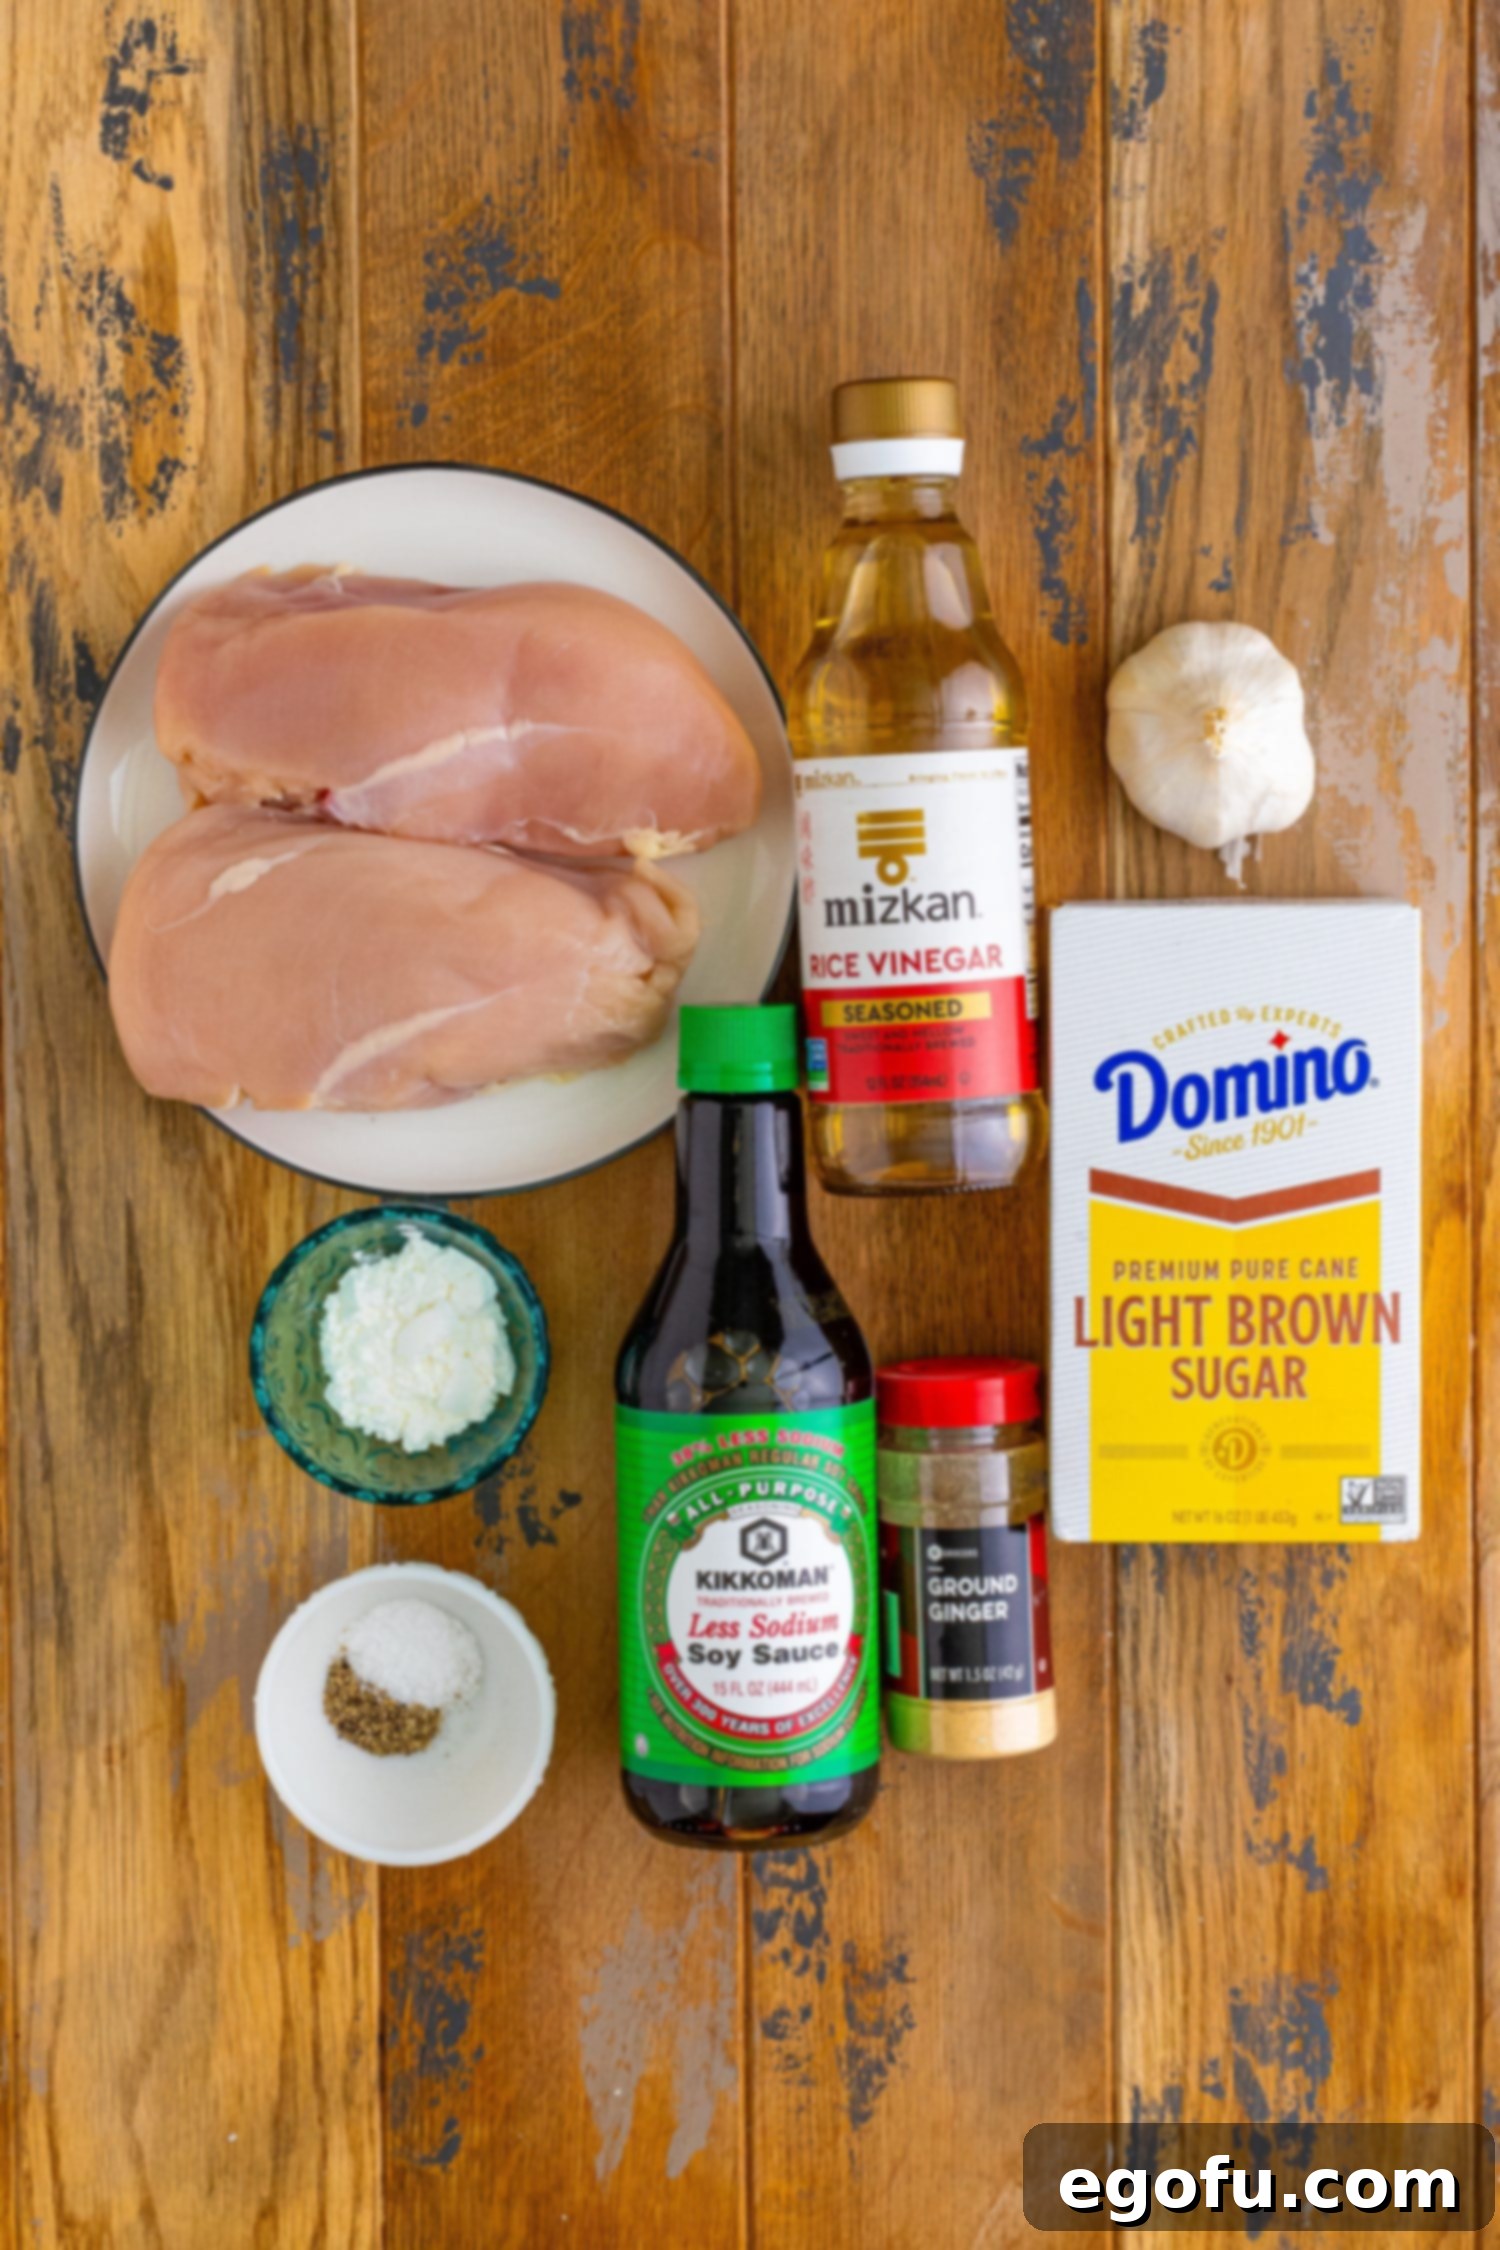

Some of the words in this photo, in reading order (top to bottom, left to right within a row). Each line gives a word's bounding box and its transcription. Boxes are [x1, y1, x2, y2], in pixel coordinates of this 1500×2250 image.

[824, 884, 977, 928] mizkan
[810, 952, 860, 979] RICE
[866, 944, 1003, 976] VINEGAR
[843, 998, 963, 1024] SEASONED
[1152, 1008, 1231, 1050] CRAFTED
[1261, 1005, 1342, 1039] EXPERTS
[1094, 1038, 1371, 1143] Domino
[1113, 1260, 1220, 1281] PREMIUM
[1231, 1259, 1290, 1280] PURE
[1300, 1257, 1359, 1279] CANE
[1073, 1294, 1212, 1348] LIGHT
[1227, 1291, 1402, 1347] BROWN
[1170, 1355, 1308, 1400] SUGAR
[717, 1429, 769, 1449] LESS
[696, 1567, 829, 1590] KIKKOMAN
[928, 1575, 1018, 1596] GROUND
[688, 1613, 740, 1639] Less
[749, 1611, 839, 1638] Sodium
[928, 1602, 1009, 1622] GINGER
[688, 1643, 741, 1669] Soy
[753, 1642, 839, 1665] Sauce
[721, 1715, 770, 1735] YEARS
[774, 1713, 797, 1733] OF
